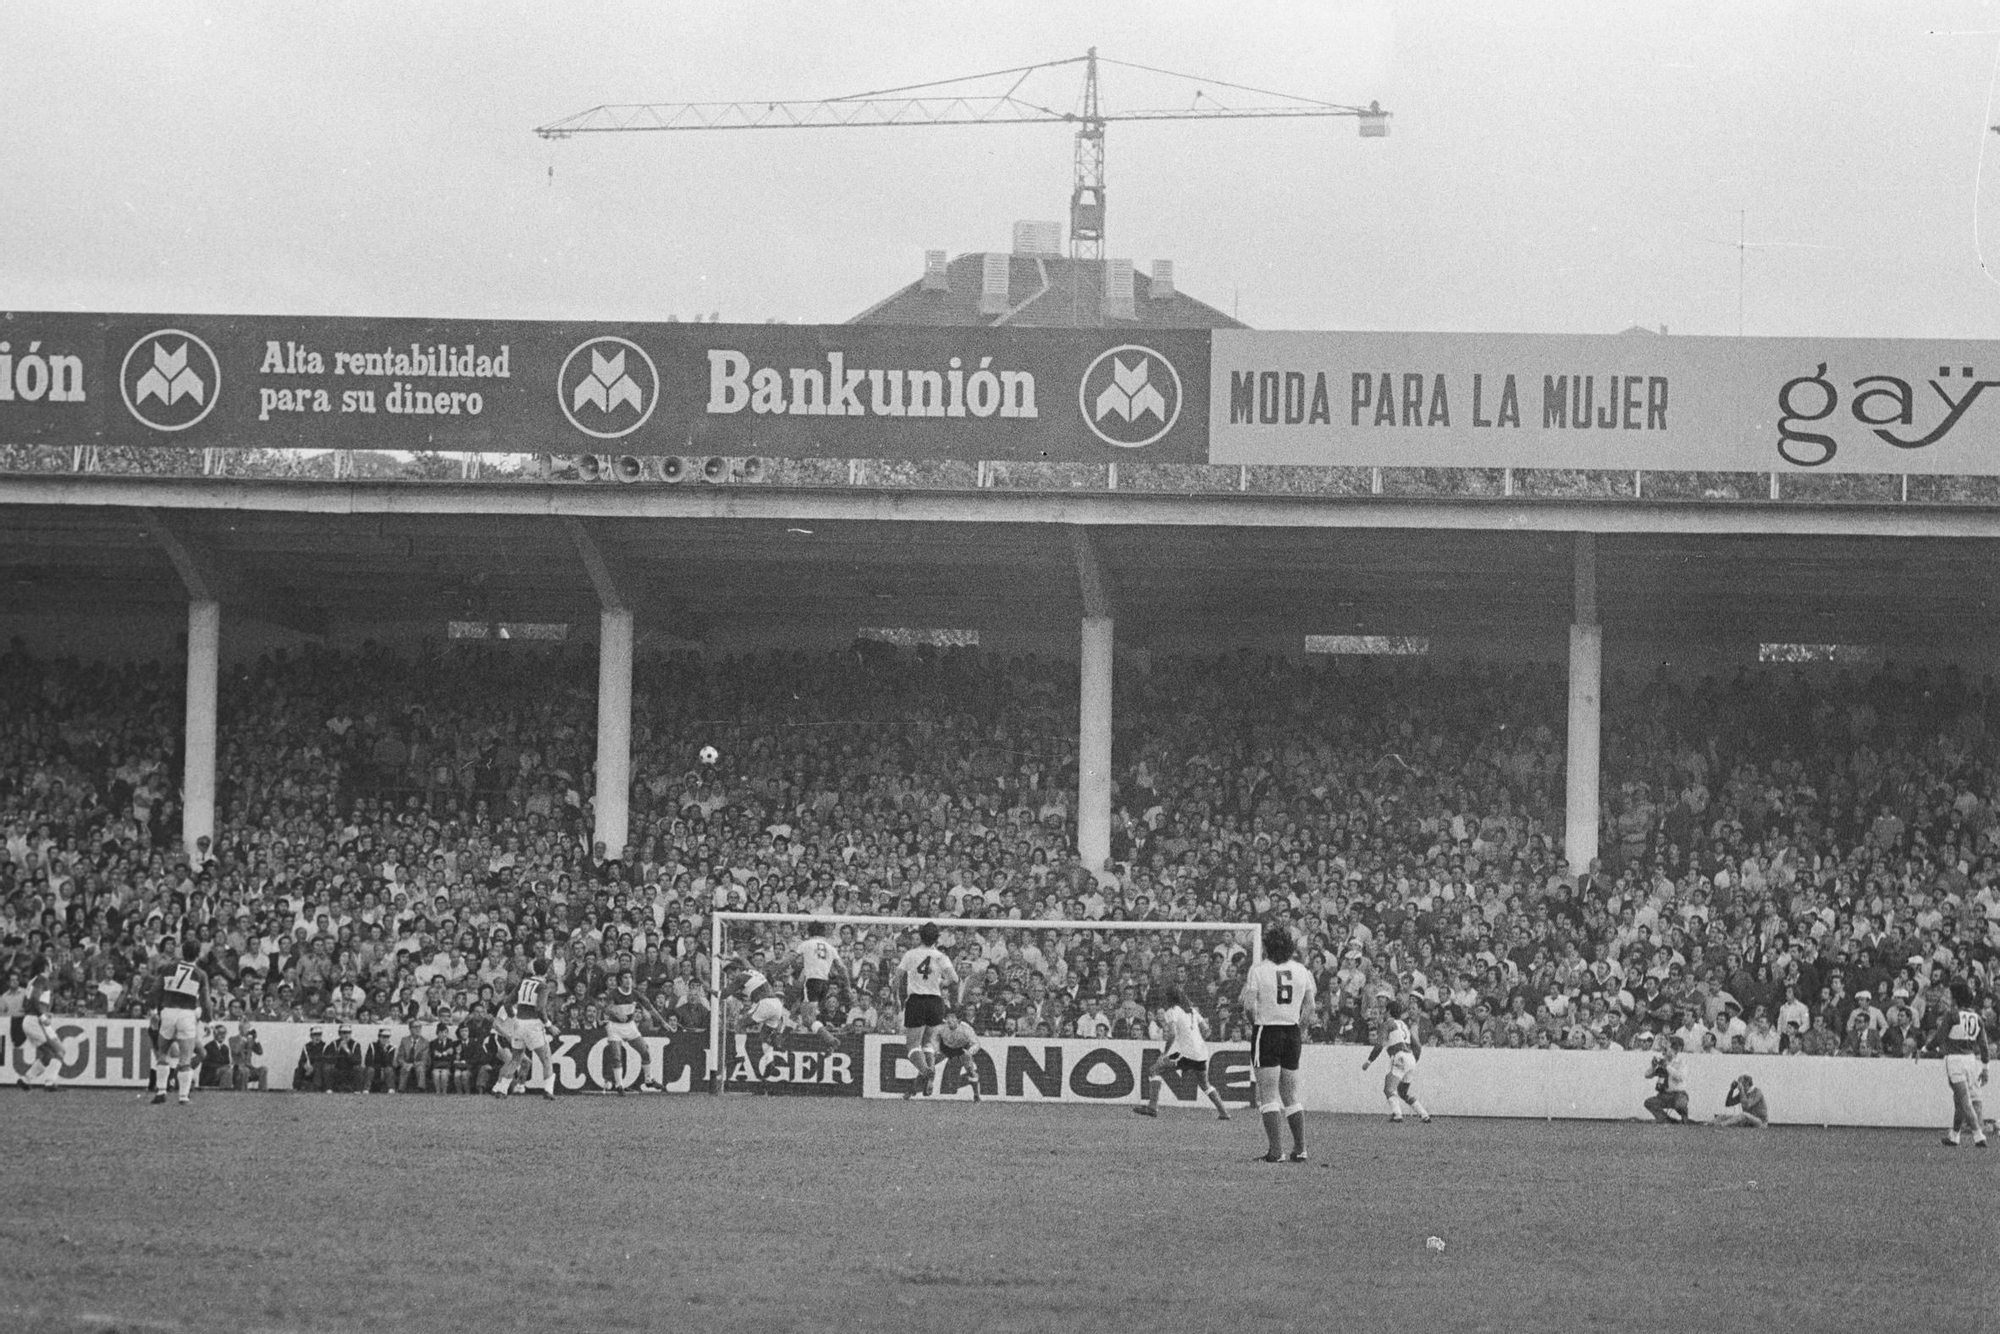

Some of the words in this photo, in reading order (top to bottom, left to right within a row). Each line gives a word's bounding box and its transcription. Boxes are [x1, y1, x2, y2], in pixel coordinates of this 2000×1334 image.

[259, 340, 325, 375] Alta
[333, 343, 512, 379] rentabilidad
[258, 384, 332, 420] para
[341, 389, 377, 414] su
[385, 381, 484, 416] dinero
[705, 347, 1039, 419] Bankunión
[1230, 370, 1332, 426] MODA
[1350, 371, 1452, 427] PARA
[1472, 373, 1521, 429] LA
[1542, 374, 1670, 431] MUJER
[175, 965, 193, 991] 7
[917, 955, 932, 980] 4
[521, 980, 538, 1004] 11
[1276, 969, 1293, 1005] 6
[1962, 1014, 1977, 1037] 10
